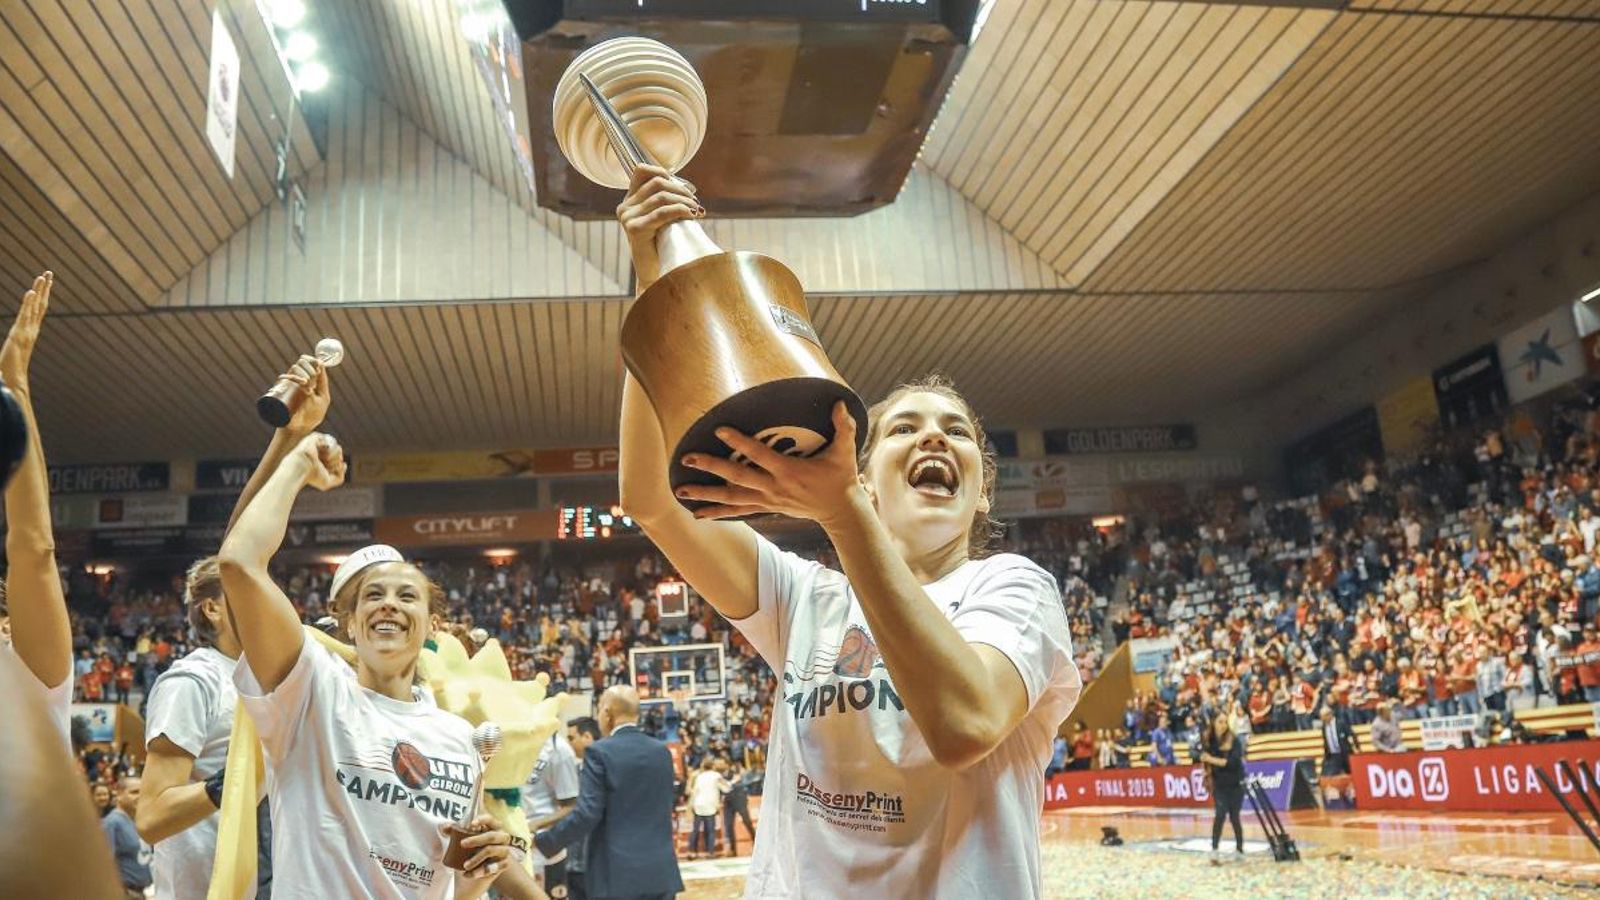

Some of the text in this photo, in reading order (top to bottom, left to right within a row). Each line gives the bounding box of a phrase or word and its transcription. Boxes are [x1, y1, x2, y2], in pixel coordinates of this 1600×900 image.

[414, 516, 518, 535] CITYLIFT
[785, 679, 905, 719] MPION
[429, 760, 473, 784] UNI
[1474, 765, 1542, 794] LIGA
[1095, 779, 1126, 797] FINAL
[1127, 777, 1155, 797] 2019
